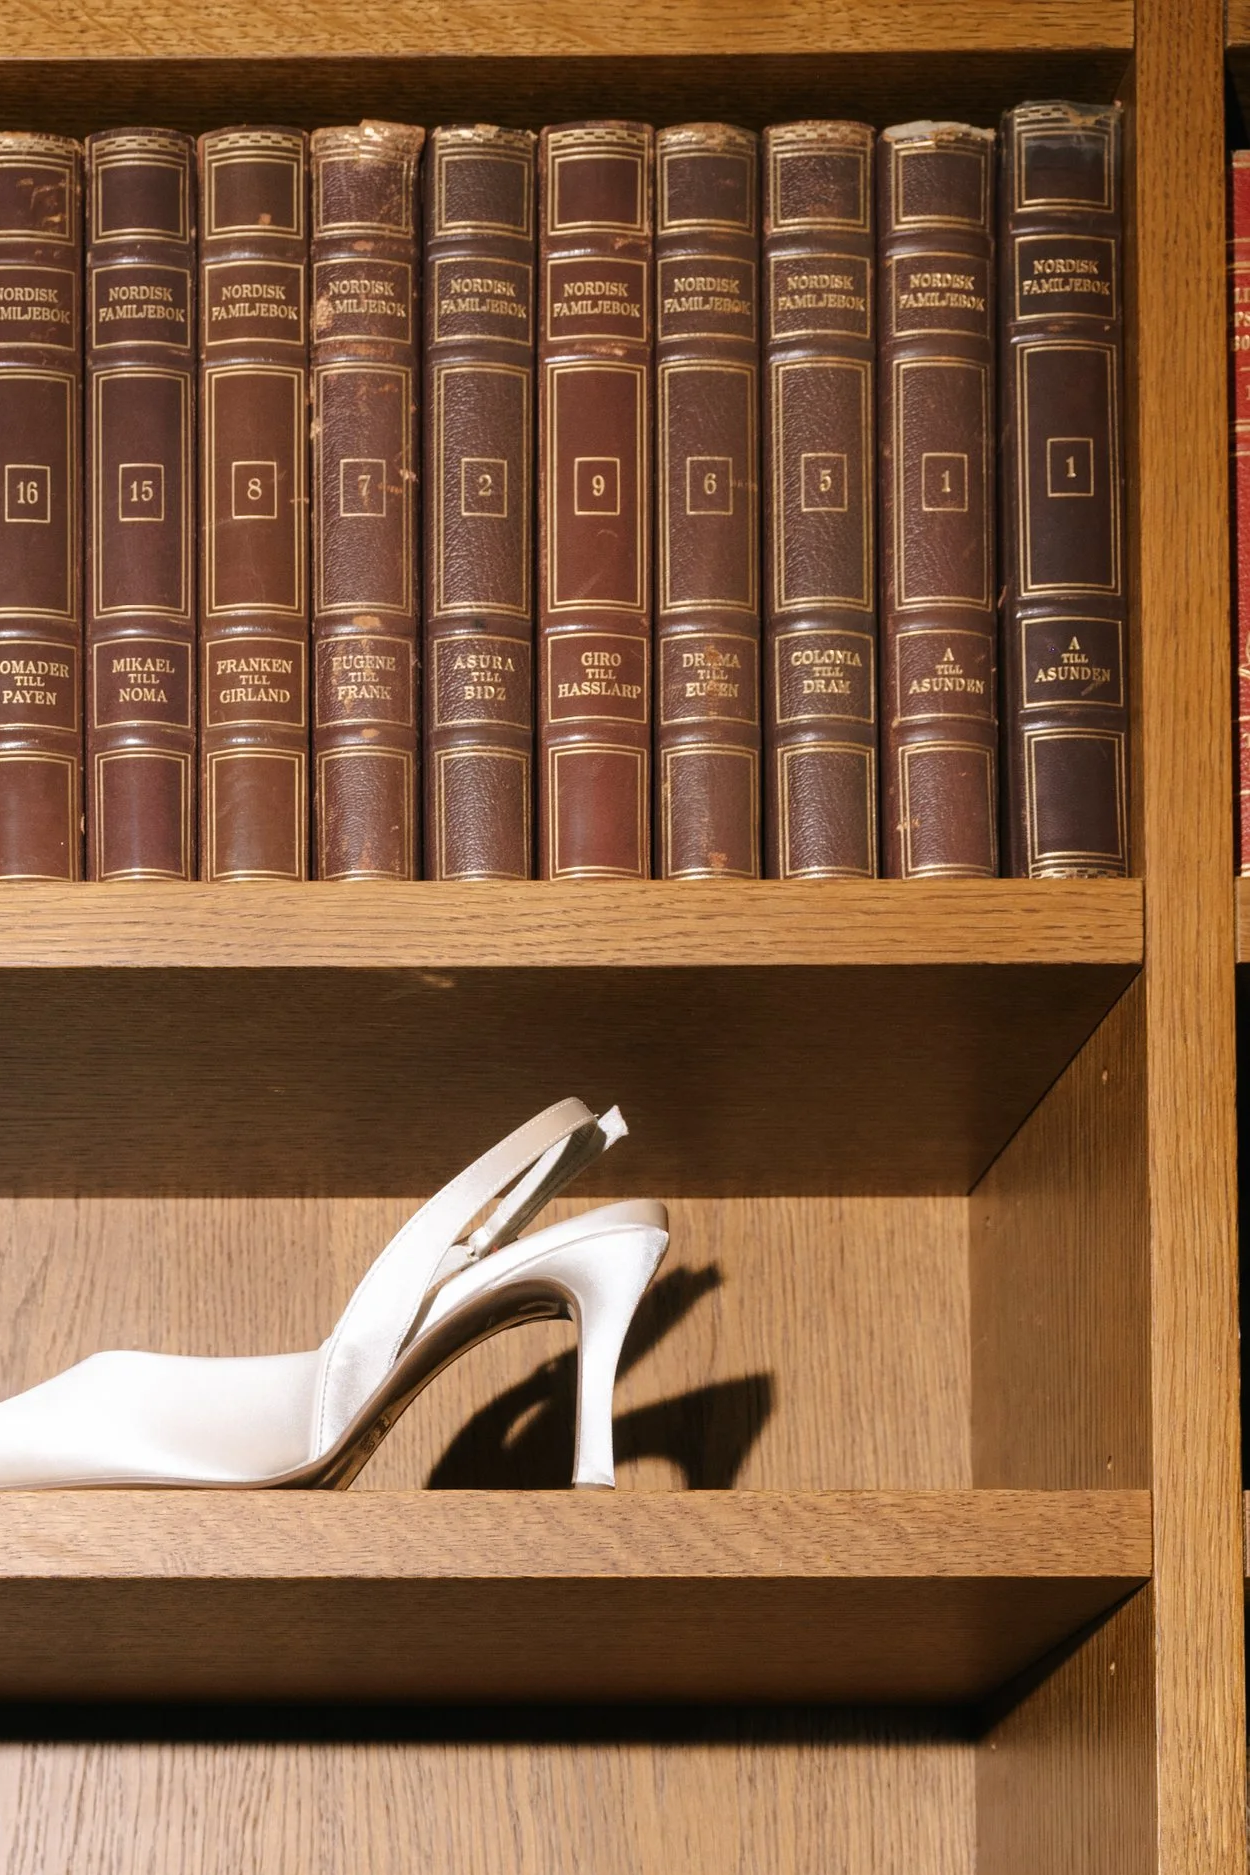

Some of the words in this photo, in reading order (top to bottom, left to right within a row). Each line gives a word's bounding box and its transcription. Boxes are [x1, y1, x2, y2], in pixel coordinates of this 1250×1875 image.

[1033, 259, 1099, 274] NORDISK
[329, 280, 394, 297] NORDISK
[450, 279, 516, 296] NORDISK
[674, 277, 740, 294] NORDISK
[787, 275, 854, 290] NORDISK
[909, 273, 975, 290] NORDISK
[1022, 278, 1110, 296] FAMILJEBOK
[108, 286, 173, 302] NORDISK
[222, 284, 286, 300] NORDISK
[564, 283, 628, 297] NORDISK
[320, 299, 407, 318] AMILJEBOK
[441, 299, 527, 319] FAMILJEBOK
[553, 302, 640, 318] FAMILJEBOK
[664, 298, 751, 315] FAMILJEBOK
[778, 294, 865, 312] FAMILJEBOK
[899, 294, 985, 312] FAMILJEBOK
[99, 305, 185, 323] FAMILJEBOK
[212, 304, 298, 321] FAMILJEBOK
[1065, 456, 1077, 478] 1
[357, 475, 372, 497] 7
[478, 475, 492, 496] 2
[592, 475, 605, 496] 9
[704, 473, 717, 494] 6
[820, 469, 832, 492] 5
[941, 469, 952, 493] 1
[17, 481, 38, 504] 16
[130, 481, 154, 502] 15
[247, 479, 262, 500] 8
[1069, 636, 1080, 650] A
[454, 654, 515, 672] ASURA
[581, 652, 622, 666] GIRO
[682, 653, 741, 668] DRMA
[791, 650, 862, 667] COLONIA
[943, 648, 955, 662] A
[1061, 652, 1089, 663] TILL
[112, 658, 175, 673] MIKAEL
[217, 658, 293, 675] FRANKEN
[332, 656, 396, 672] EUGENE
[935, 664, 963, 675] TILL
[128, 673, 160, 684] TILL
[240, 675, 270, 685] TILL
[349, 672, 379, 682] TILL
[471, 671, 501, 683] TILL
[585, 669, 616, 680] TILL
[697, 669, 728, 680] TILL
[812, 667, 843, 678] TILL
[1035, 666, 1111, 683] ASUNDEN
[14, 676, 45, 687] TILL
[802, 680, 851, 695] DRAM
[909, 678, 985, 695] ASUNDEN
[2, 690, 57, 705] PAYEN
[119, 688, 167, 703] NOMA
[220, 688, 290, 704] GIRLAND
[337, 685, 392, 701] FRANK
[464, 685, 507, 701] BIDZ
[558, 682, 642, 700] HASSLARP
